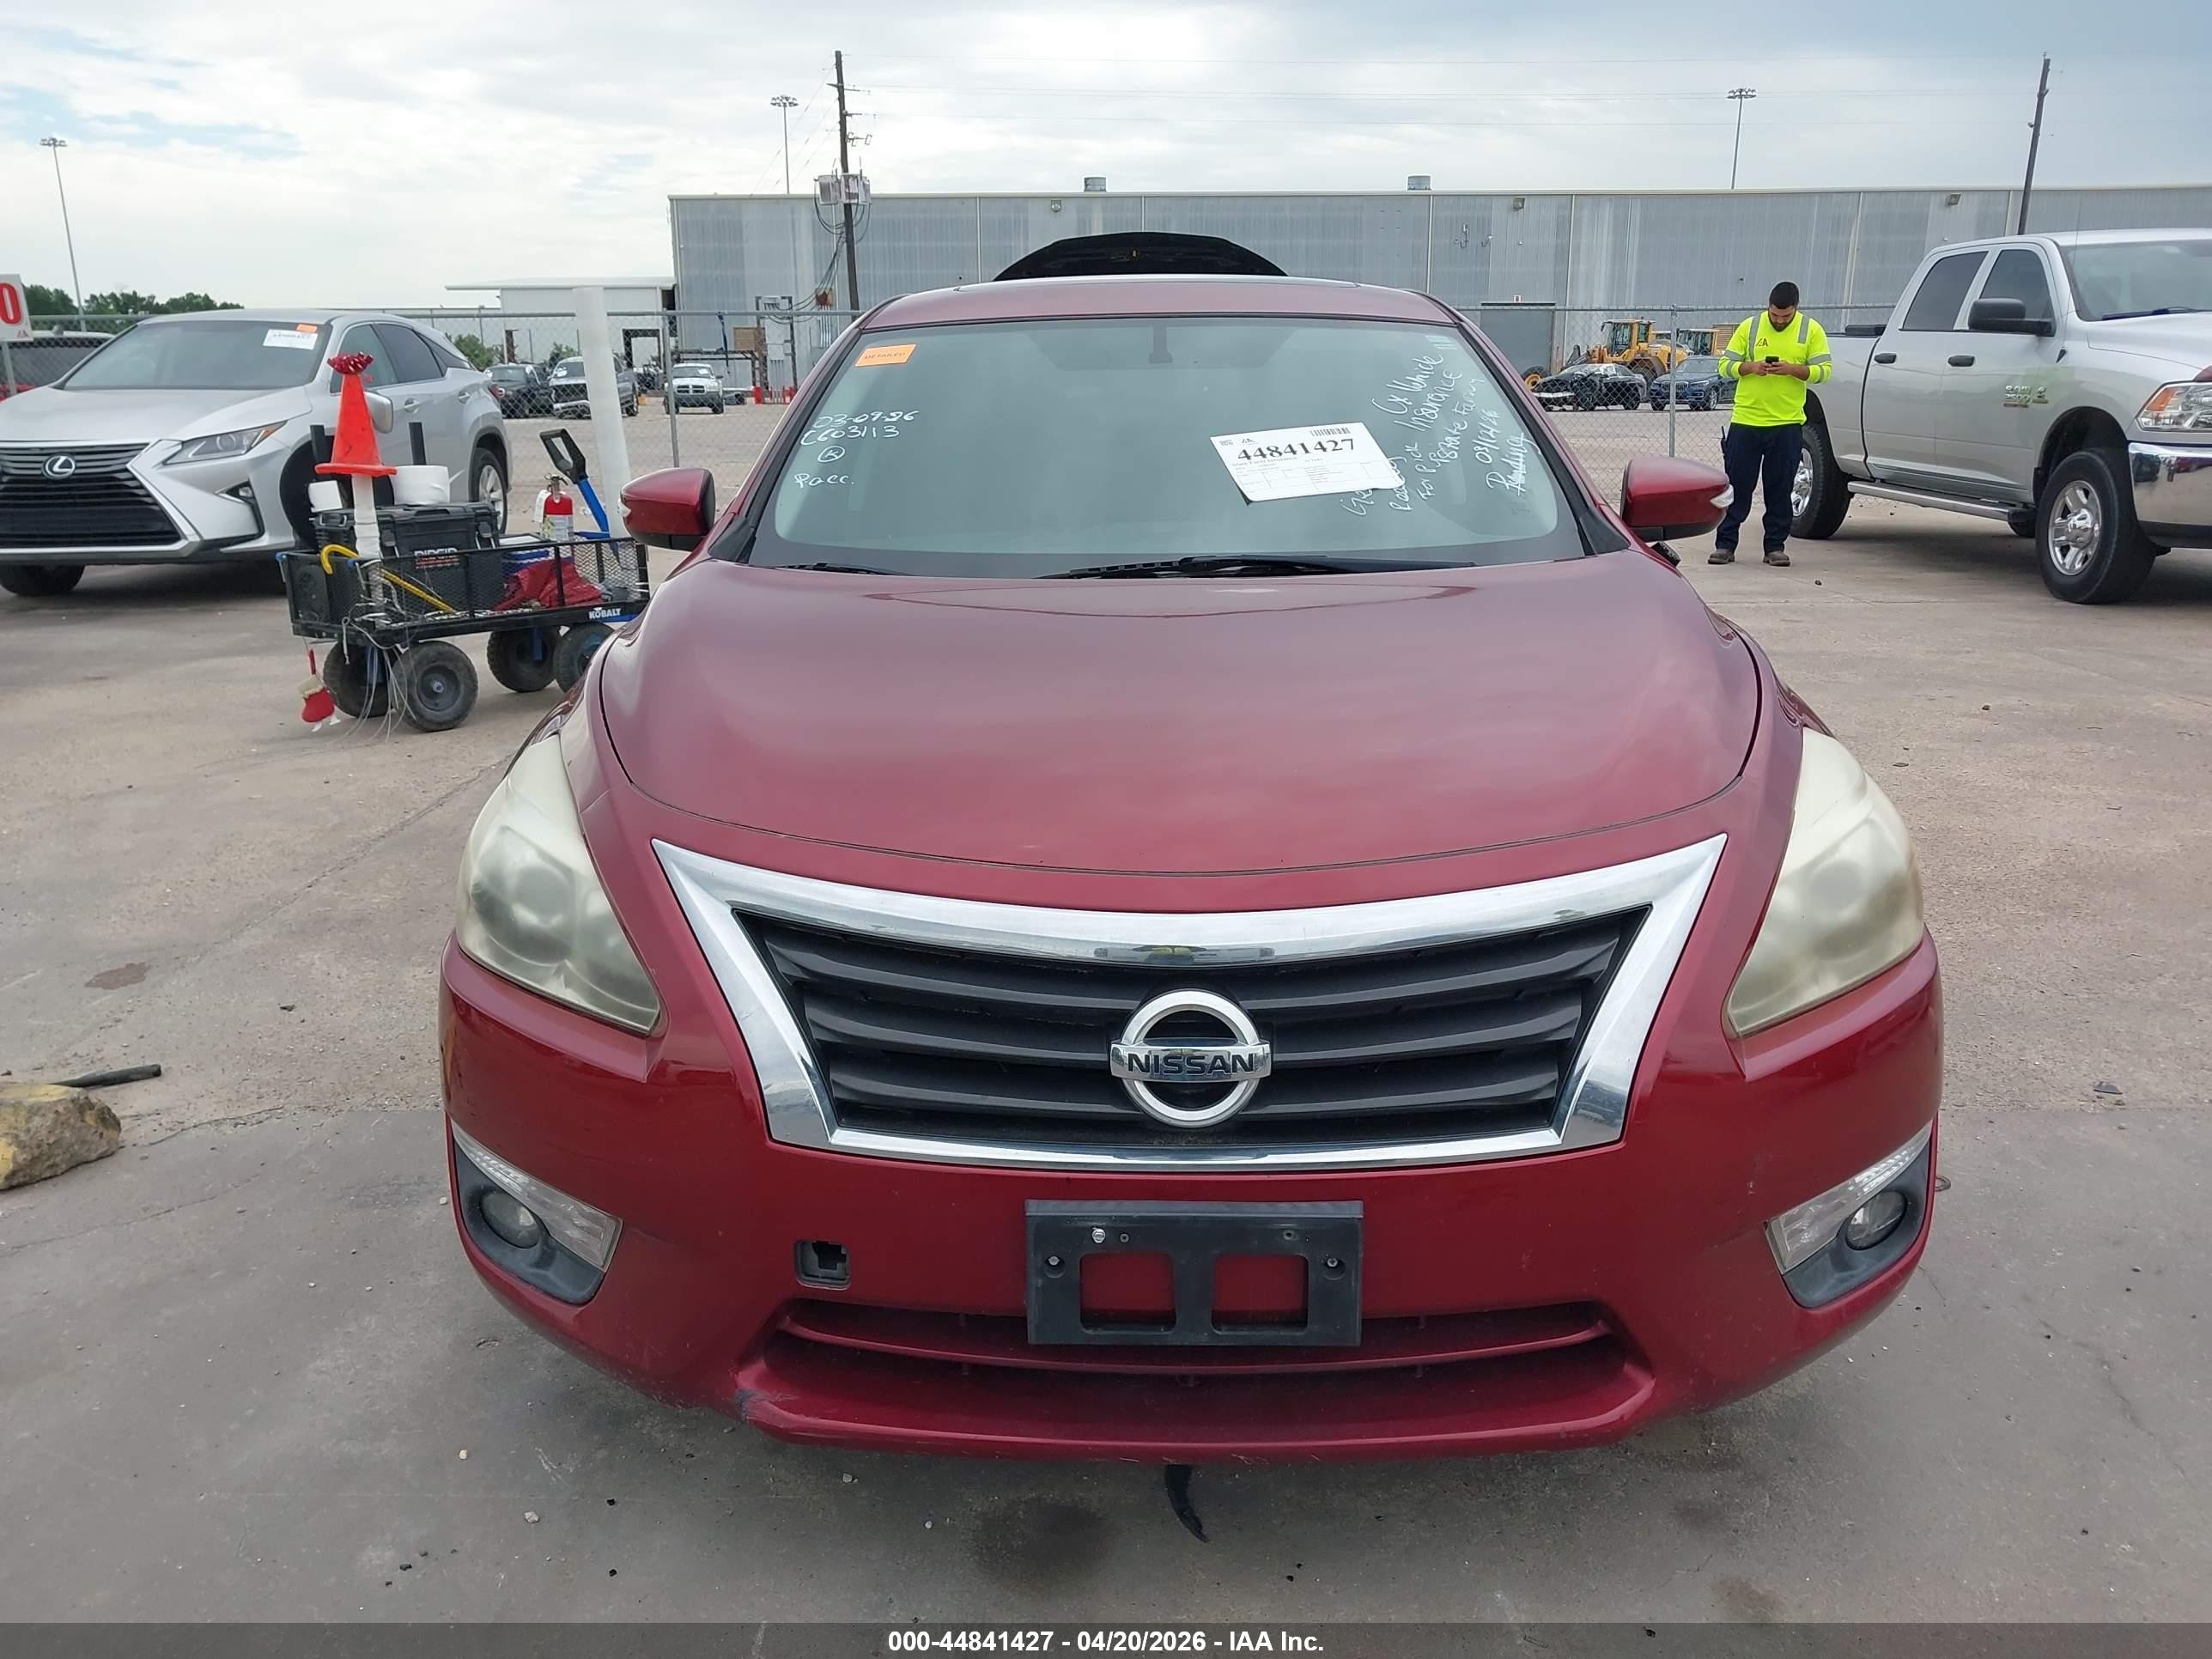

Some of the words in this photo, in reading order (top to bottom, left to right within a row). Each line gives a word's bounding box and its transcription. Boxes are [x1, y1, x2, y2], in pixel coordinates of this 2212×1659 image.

[1237, 438, 1354, 460] 44841427
[588, 608, 622, 619] KOBALT
[1127, 1053, 1254, 1074] NISSAN
